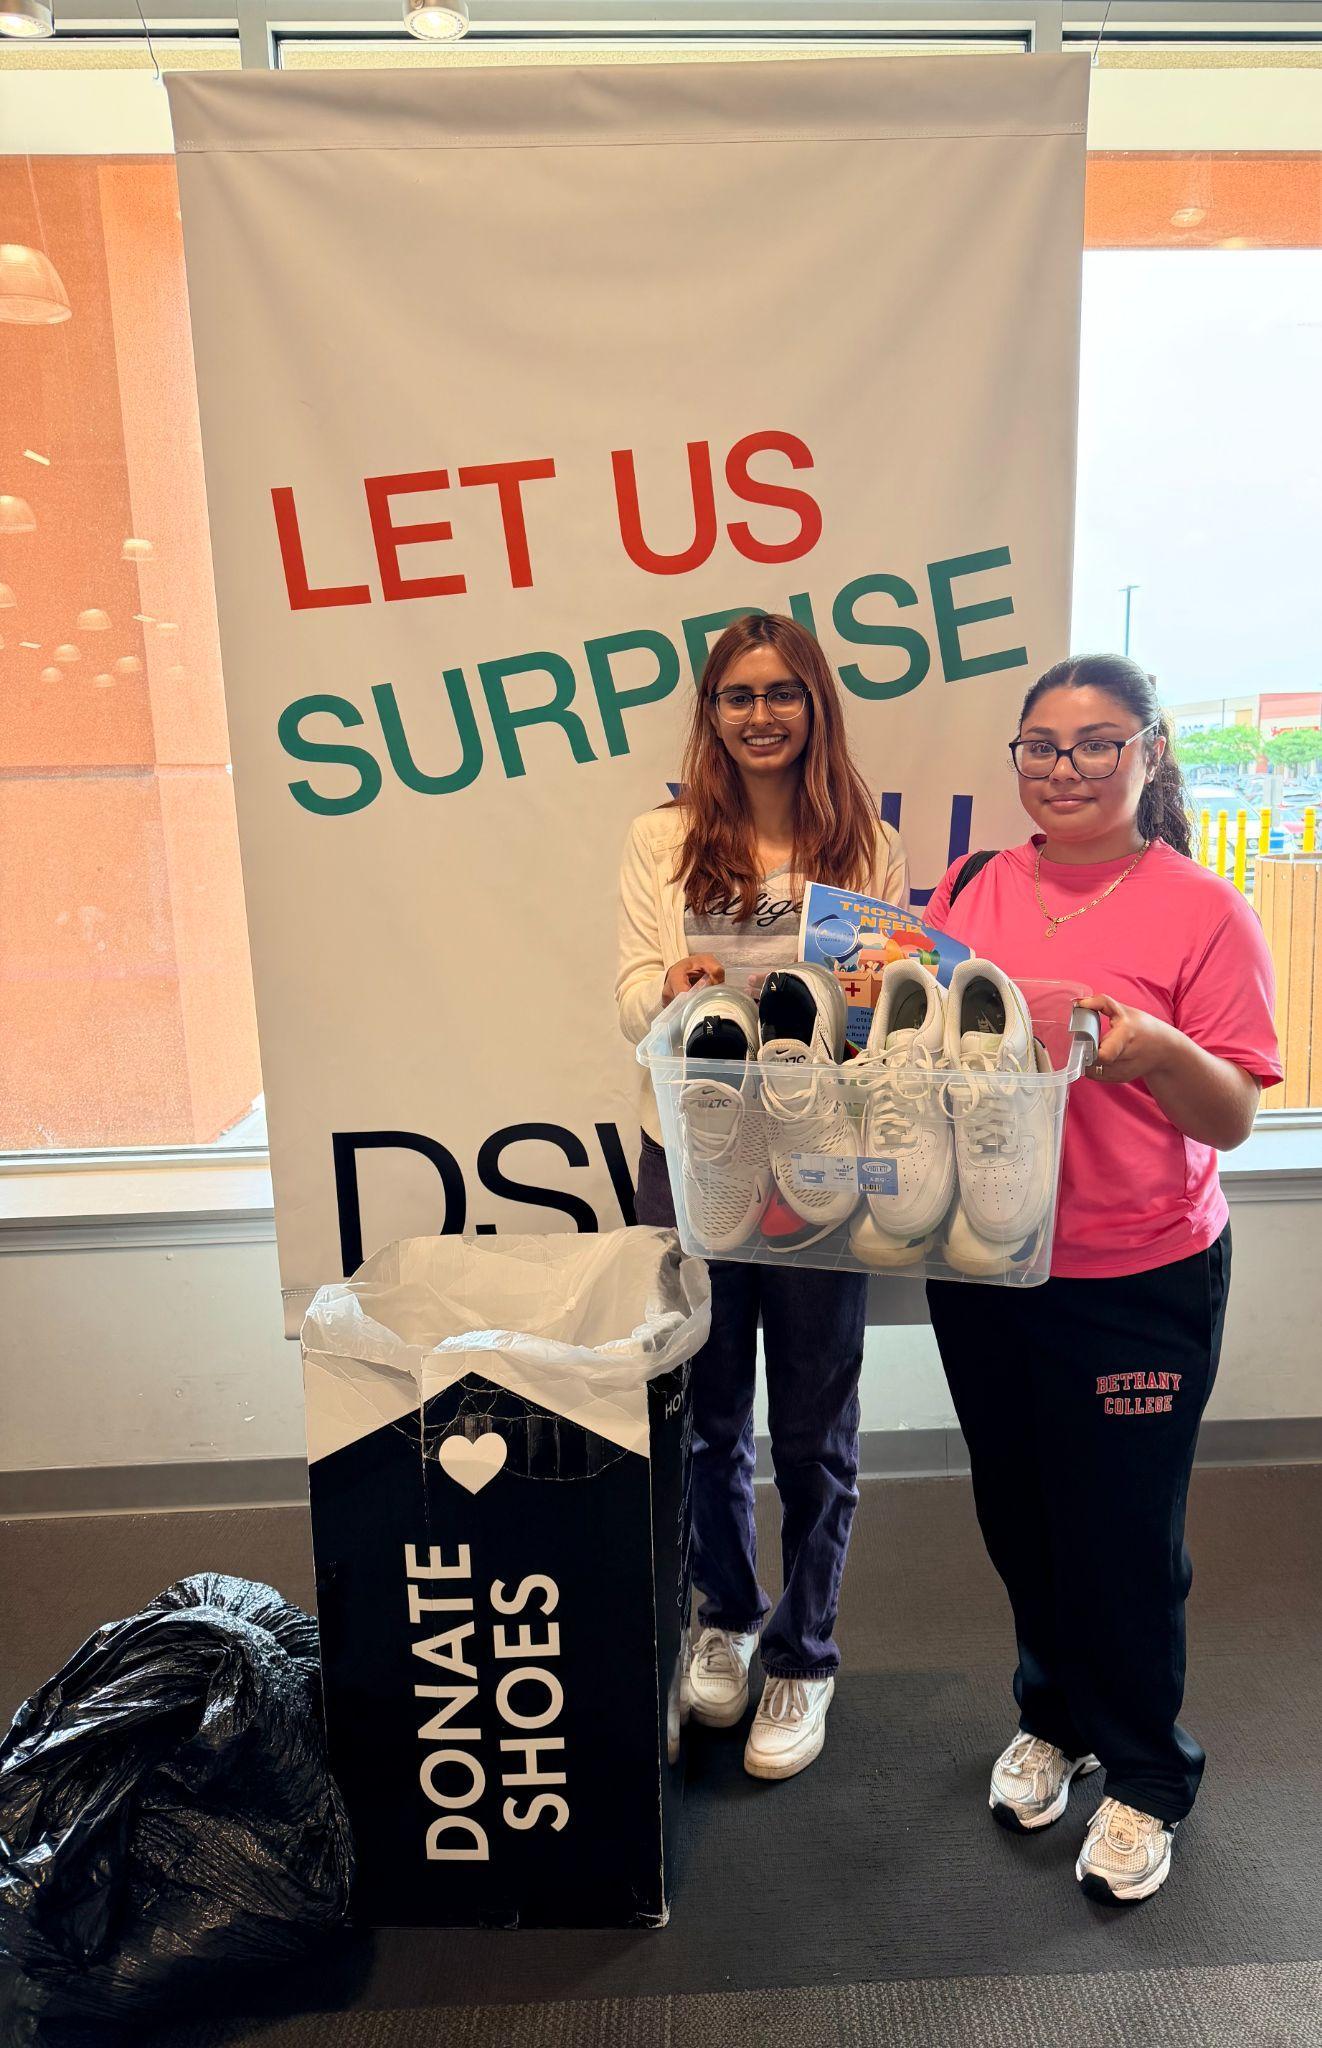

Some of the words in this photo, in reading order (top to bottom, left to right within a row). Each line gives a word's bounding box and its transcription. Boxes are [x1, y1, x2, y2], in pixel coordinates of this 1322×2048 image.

[271, 458, 556, 611] LET
[611, 430, 823, 576] US
[839, 901, 913, 924] THOSE
[332, 1122, 639, 1278] DS
[1096, 1372, 1182, 1394] BETHANY
[1104, 1395, 1173, 1415] COLLEGE
[404, 1543, 490, 1861] DONATE
[490, 1574, 570, 1833] SHOES
